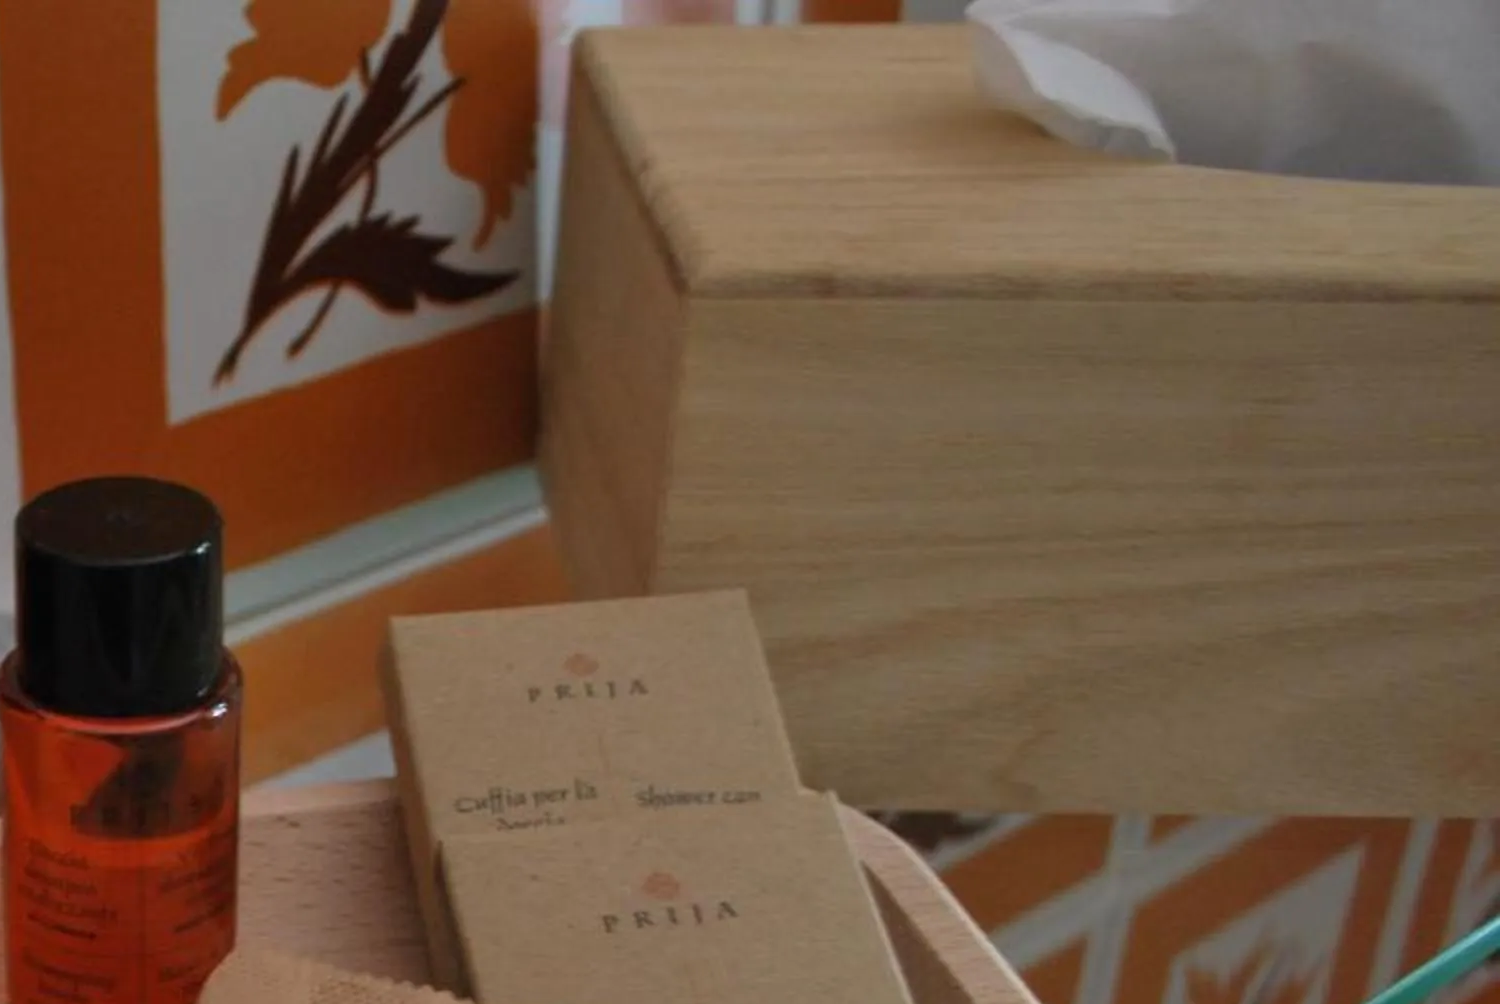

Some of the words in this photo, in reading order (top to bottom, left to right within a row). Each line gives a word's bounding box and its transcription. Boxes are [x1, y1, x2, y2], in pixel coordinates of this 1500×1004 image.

[526, 677, 650, 704] PRIJA
[531, 788, 571, 809] per
[601, 900, 740, 934] PRIJA
